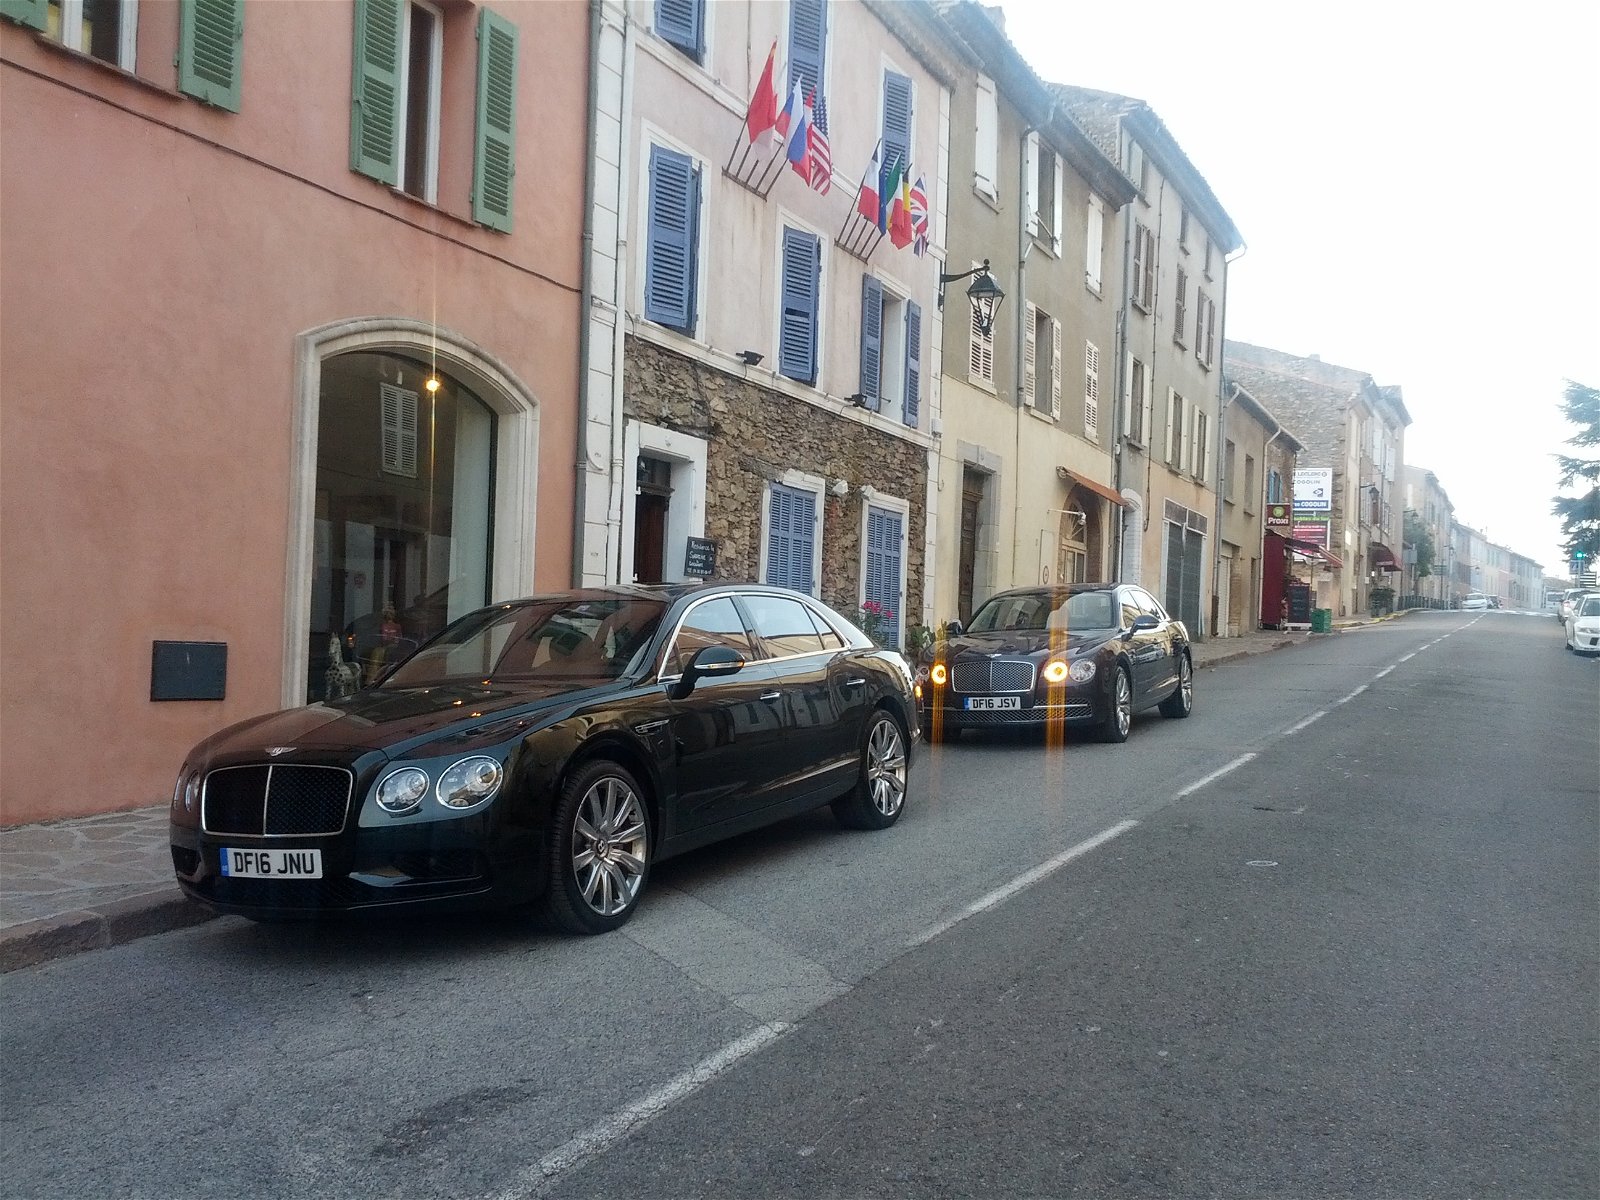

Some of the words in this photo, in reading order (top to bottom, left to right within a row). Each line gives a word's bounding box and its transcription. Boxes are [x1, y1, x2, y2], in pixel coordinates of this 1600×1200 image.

[1268, 515, 1289, 525] Proxi
[973, 698, 995, 709] DF16
[997, 698, 1017, 708] JSV
[234, 852, 271, 874] DF16
[277, 852, 315, 875] JNU
